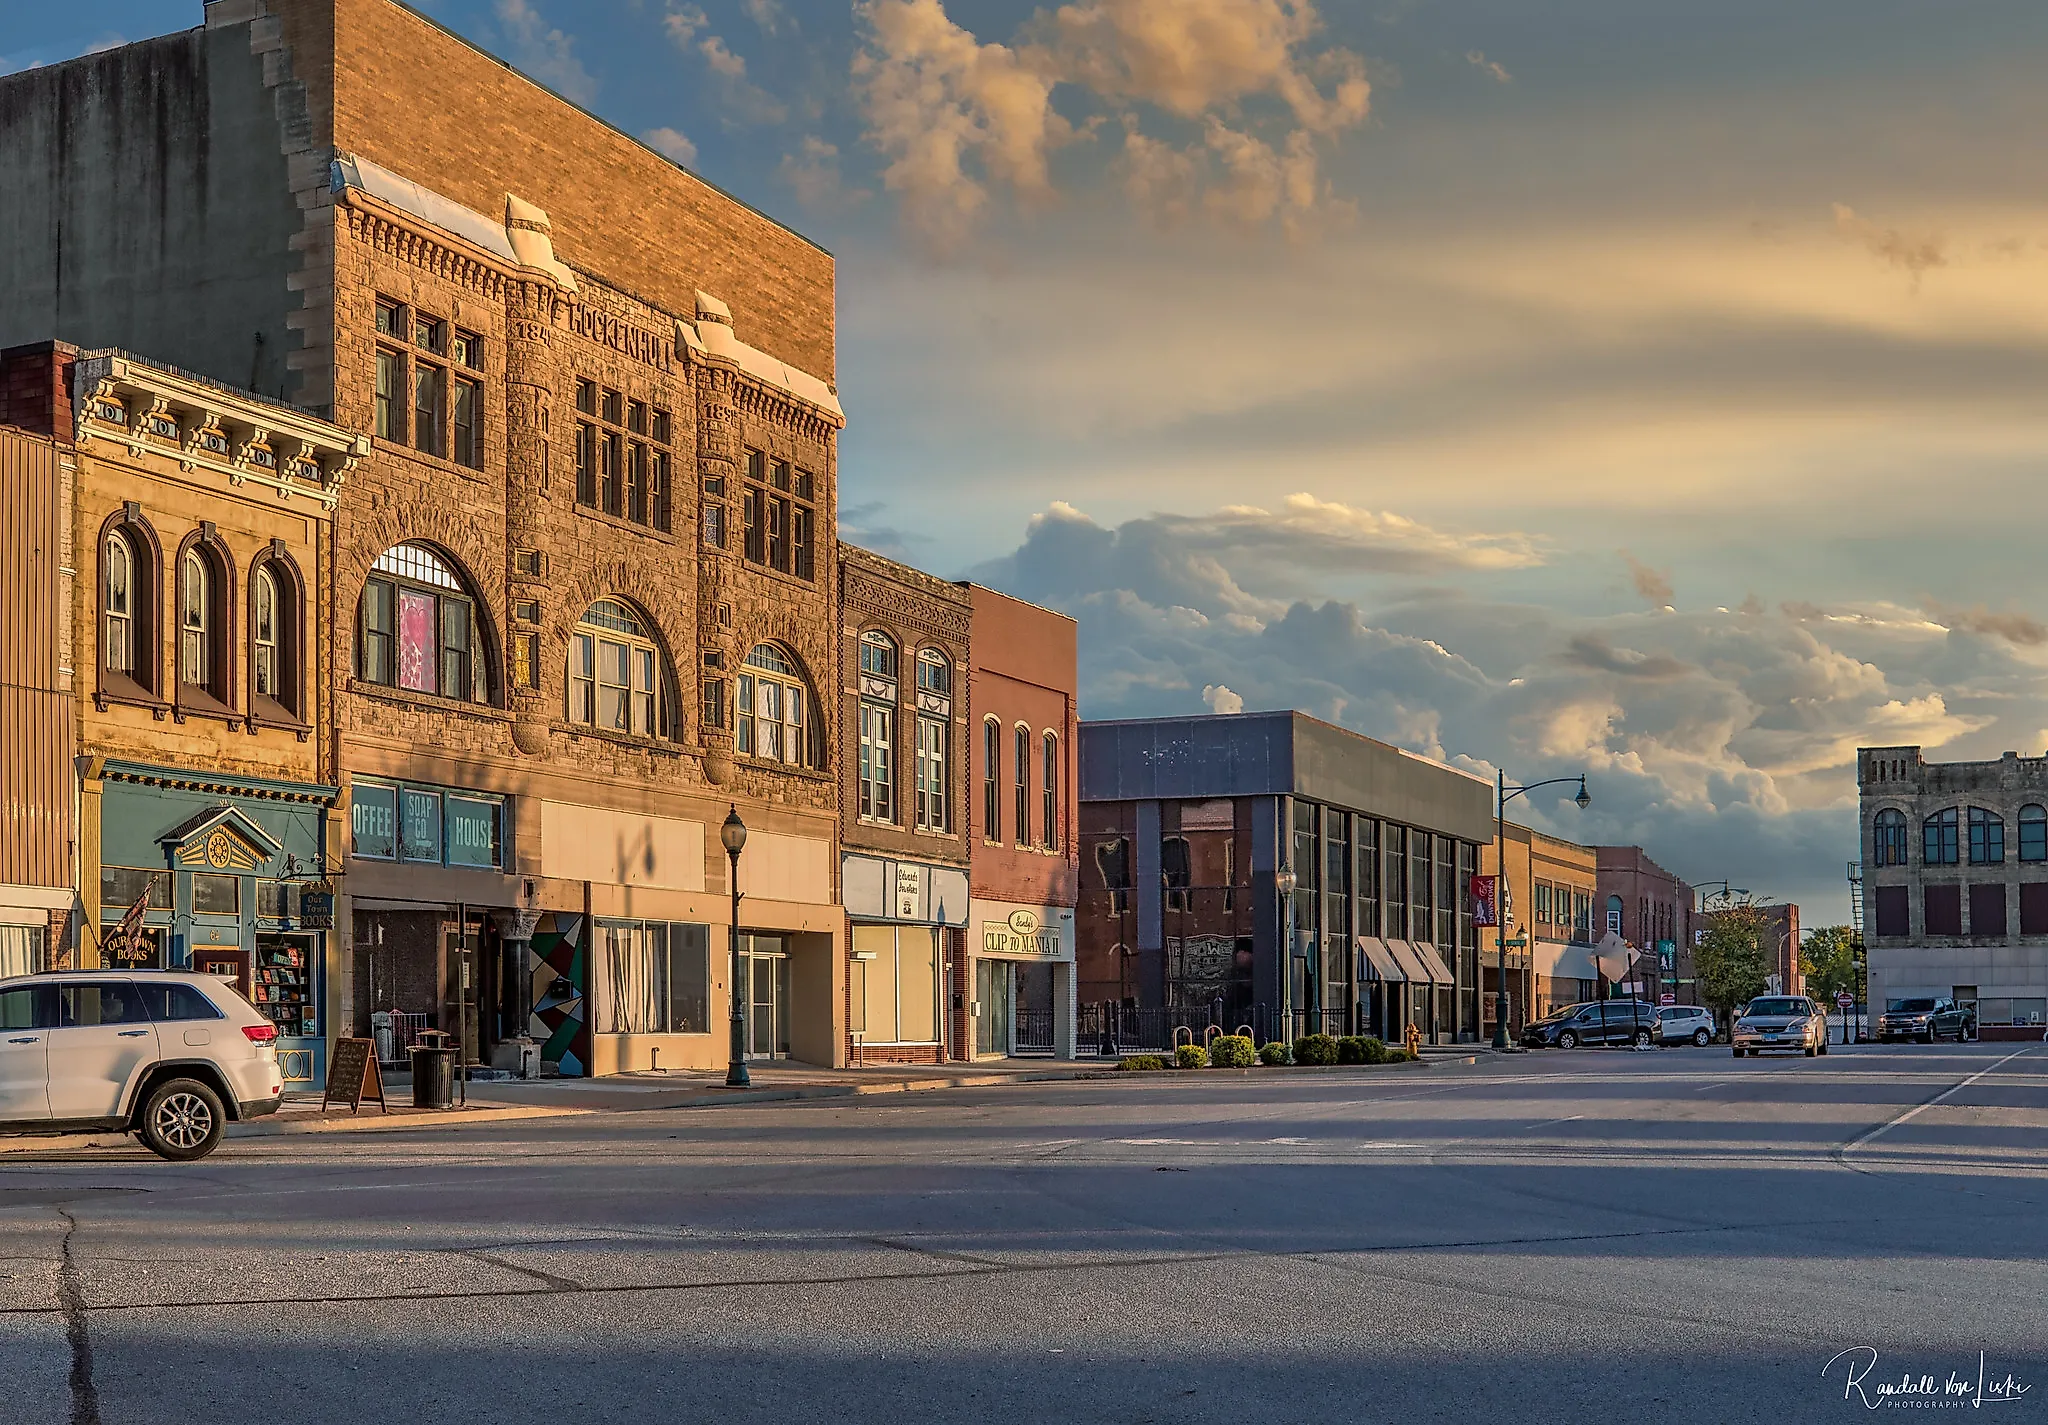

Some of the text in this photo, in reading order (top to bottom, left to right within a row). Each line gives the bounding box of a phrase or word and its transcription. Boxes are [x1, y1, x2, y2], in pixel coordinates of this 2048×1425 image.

[570, 302, 676, 376] HOCKENHULL
[408, 795, 432, 818] SOAP
[353, 803, 392, 838] OFFEE
[415, 818, 427, 839] CO
[456, 816, 494, 849] HOUSE
[305, 904, 329, 913] Town
[307, 895, 323, 904] Our
[1487, 879, 1495, 924] DOWNTOWN
[300, 915, 334, 927] BOOKS
[108, 936, 127, 951] OUR
[985, 932, 1008, 951] CLIP
[1010, 936, 1020, 951] TO
[1022, 935, 1051, 954] MANIA
[117, 949, 148, 961] BOOKS
